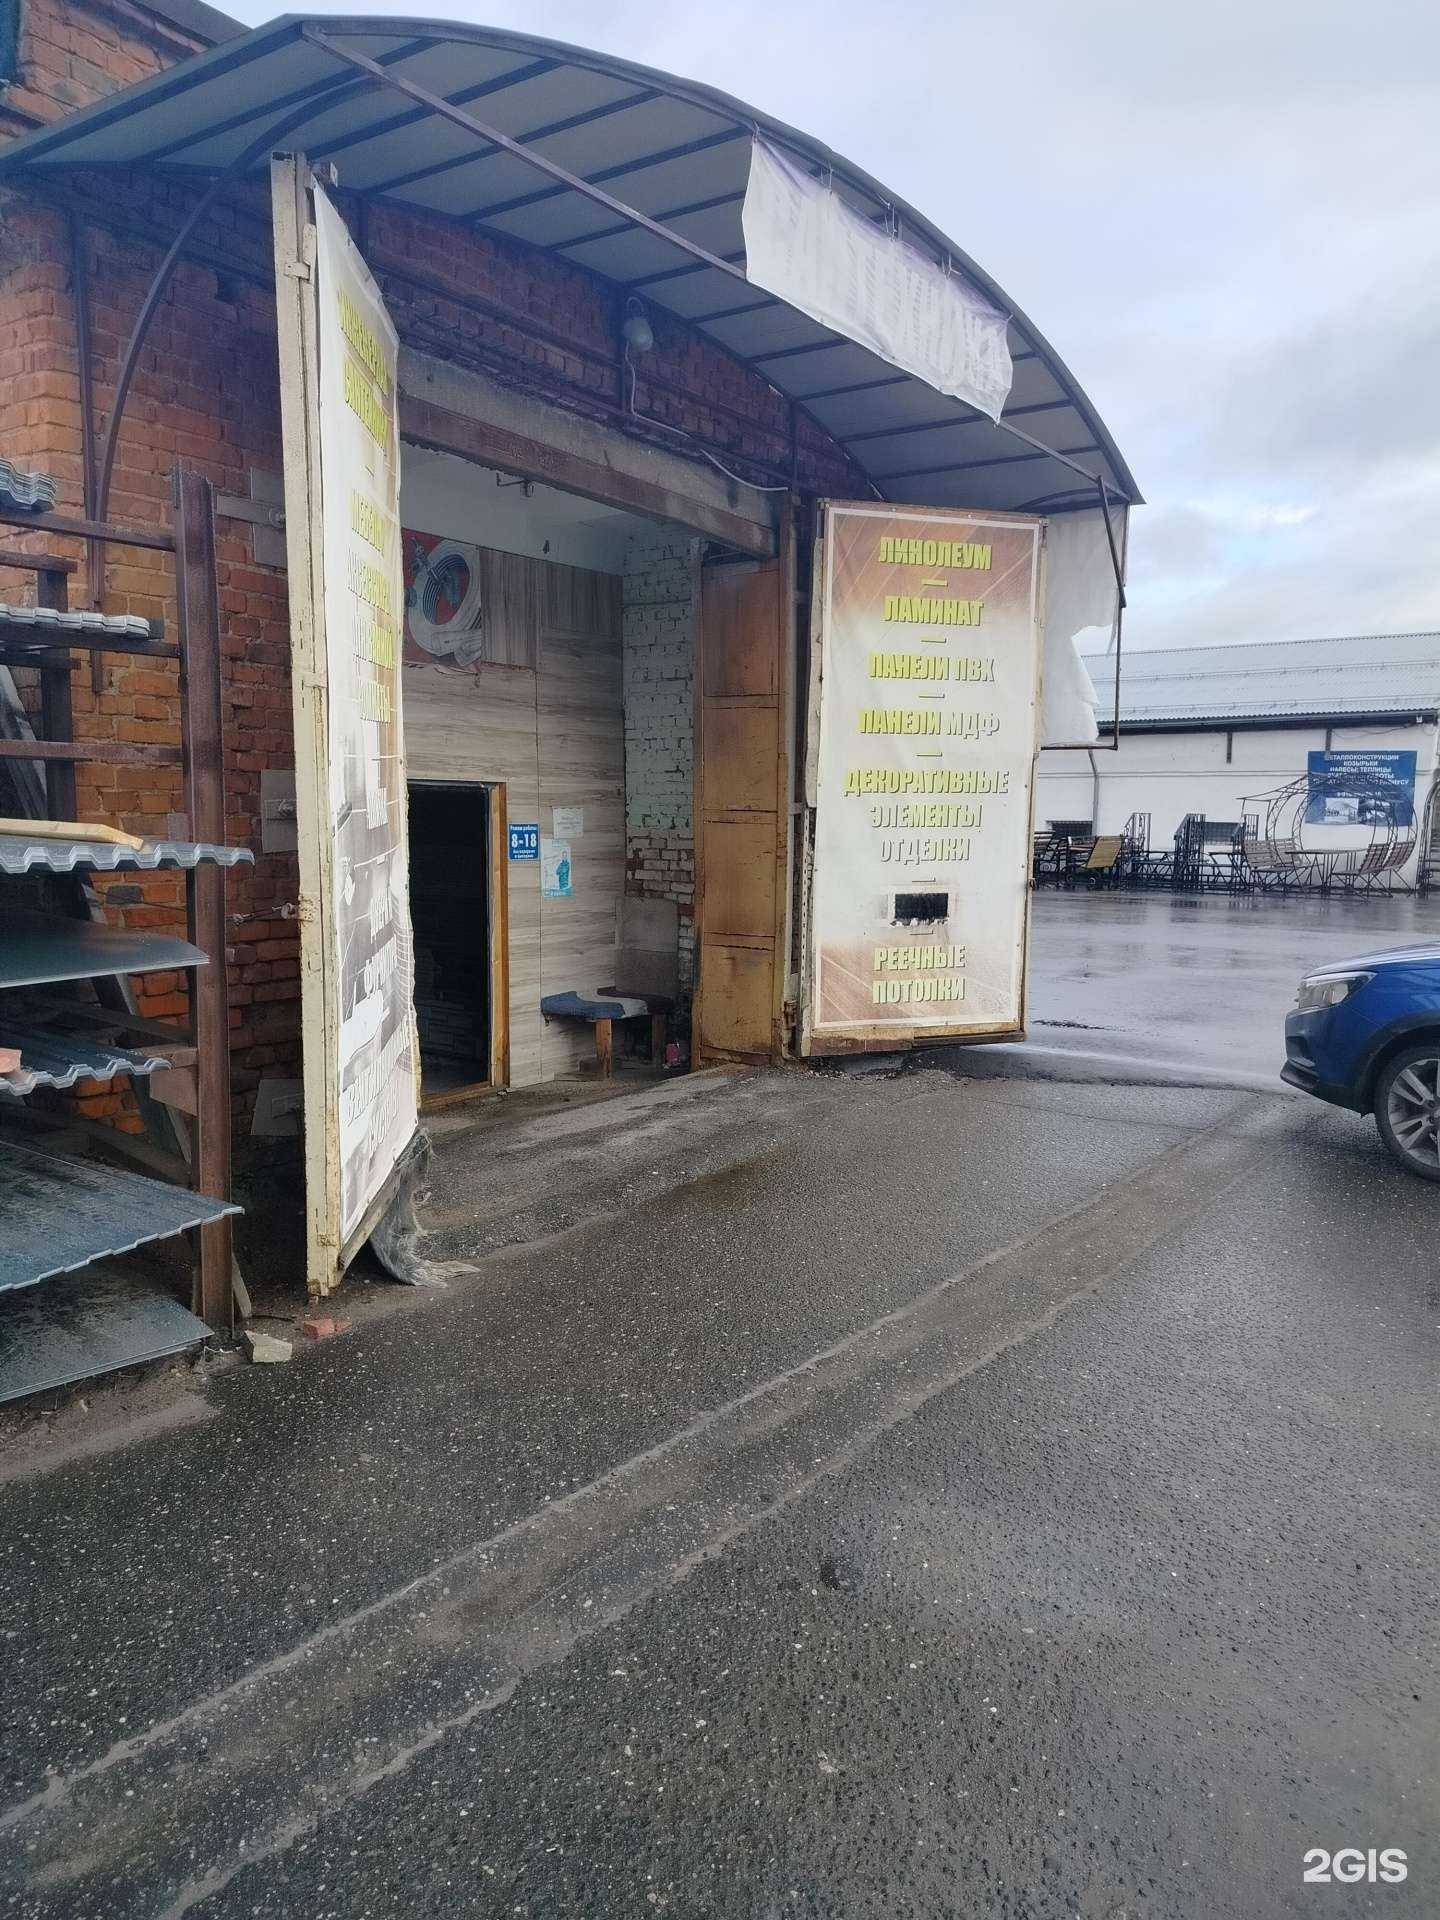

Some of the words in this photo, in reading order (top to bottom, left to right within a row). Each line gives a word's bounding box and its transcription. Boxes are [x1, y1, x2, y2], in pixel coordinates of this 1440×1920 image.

[878, 536, 992, 570] ЛИНОЛЕУМ
[881, 596, 984, 626] ЛАМИНАТ
[869, 653, 949, 680] ПАНЕЛИ
[954, 656, 995, 682] ПВХ
[859, 710, 942, 735] ПАНЕЛИ
[946, 711, 1000, 739] МДФ
[844, 768, 1009, 797] ДЕКОРАТИВНЫЕ
[870, 804, 983, 829] ЭЛЕМЕНТЫ
[511, 833, 537, 848] 8-18
[880, 838, 971, 865] ОТДЕЛКИ
[873, 945, 966, 971] РЕЕЧНЫЕ
[872, 977, 966, 1004] ПОТОЛКИ
